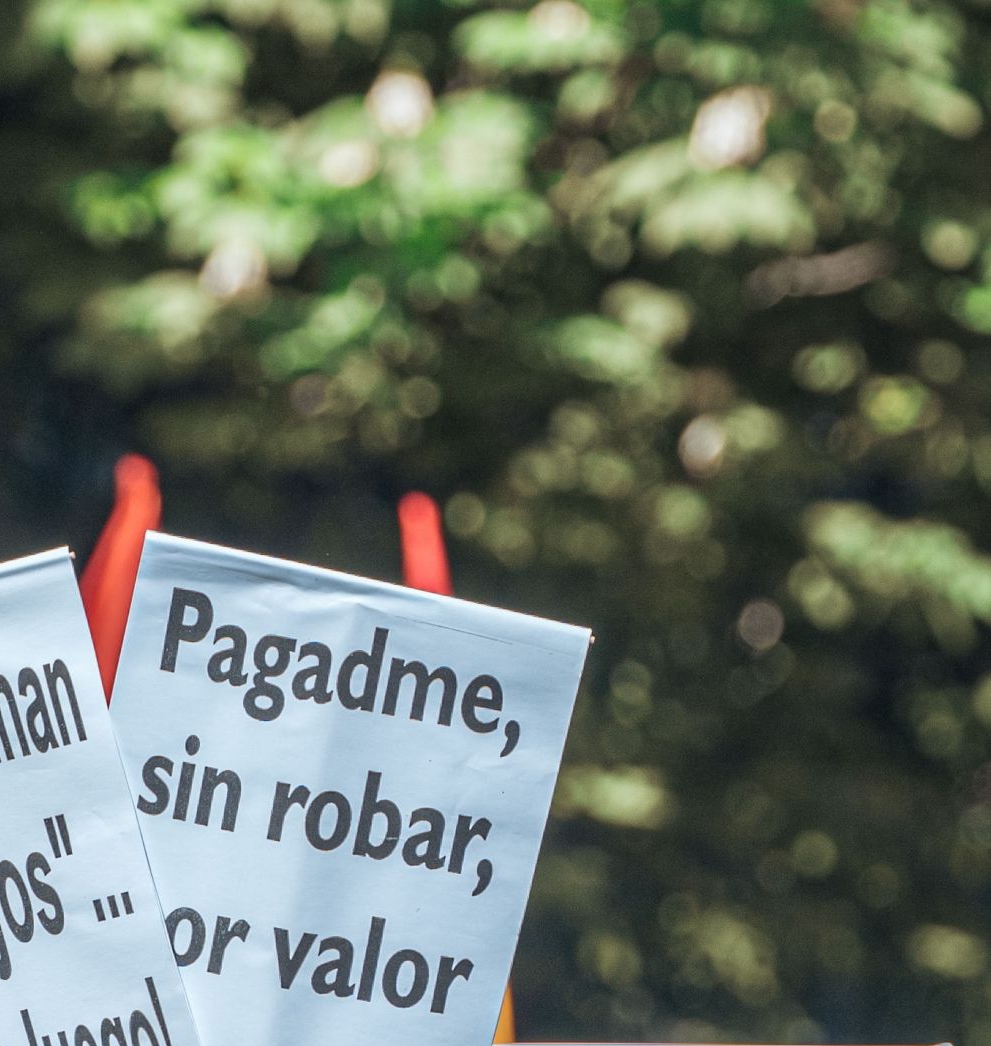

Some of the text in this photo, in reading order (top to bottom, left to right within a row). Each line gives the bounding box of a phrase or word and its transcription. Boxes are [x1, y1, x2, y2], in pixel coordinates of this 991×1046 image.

[160, 587, 520, 758] Pagadme,
[137, 734, 494, 897] sin robar,
[164, 905, 475, 1015] or valor
